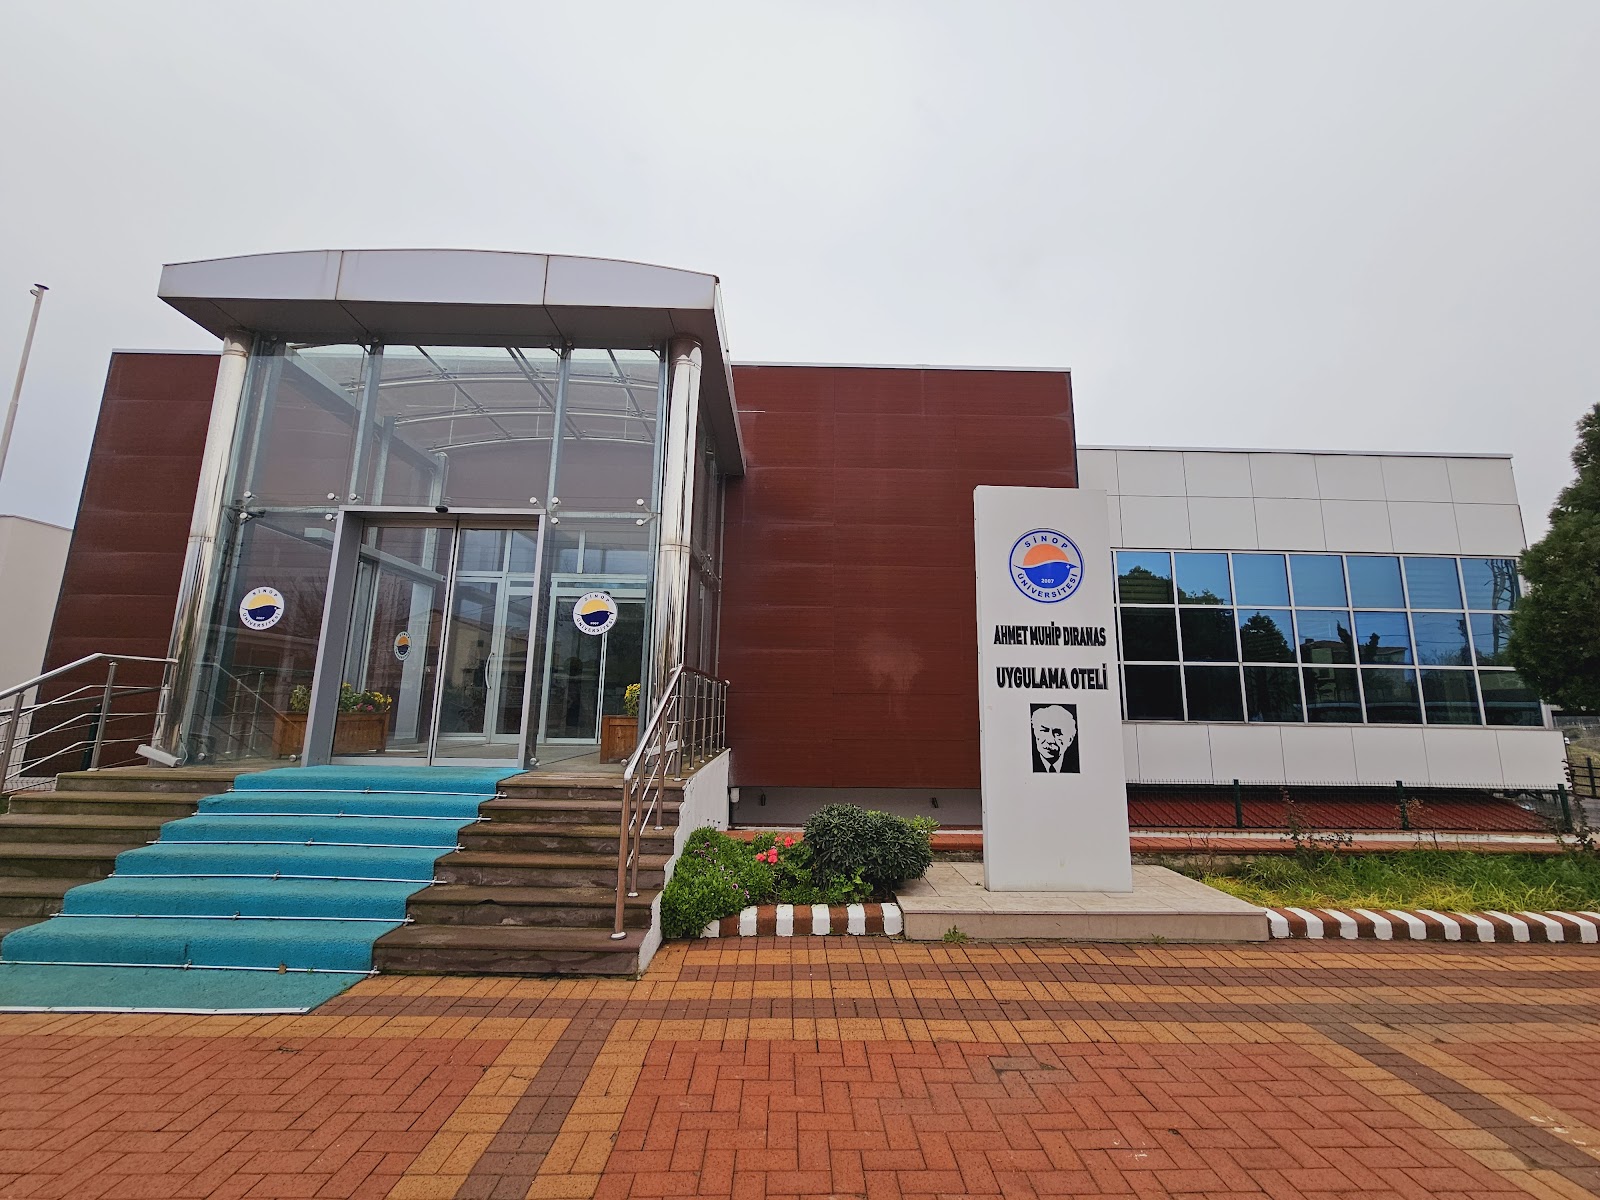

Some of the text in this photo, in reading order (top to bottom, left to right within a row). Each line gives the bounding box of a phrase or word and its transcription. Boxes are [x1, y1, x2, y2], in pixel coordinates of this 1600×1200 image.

[1024, 535, 1068, 548] SİNOP
[993, 620, 1107, 647] AHMET MUHİP DIRANAS
[996, 662, 1109, 690] UYGULAMA OTELİ
